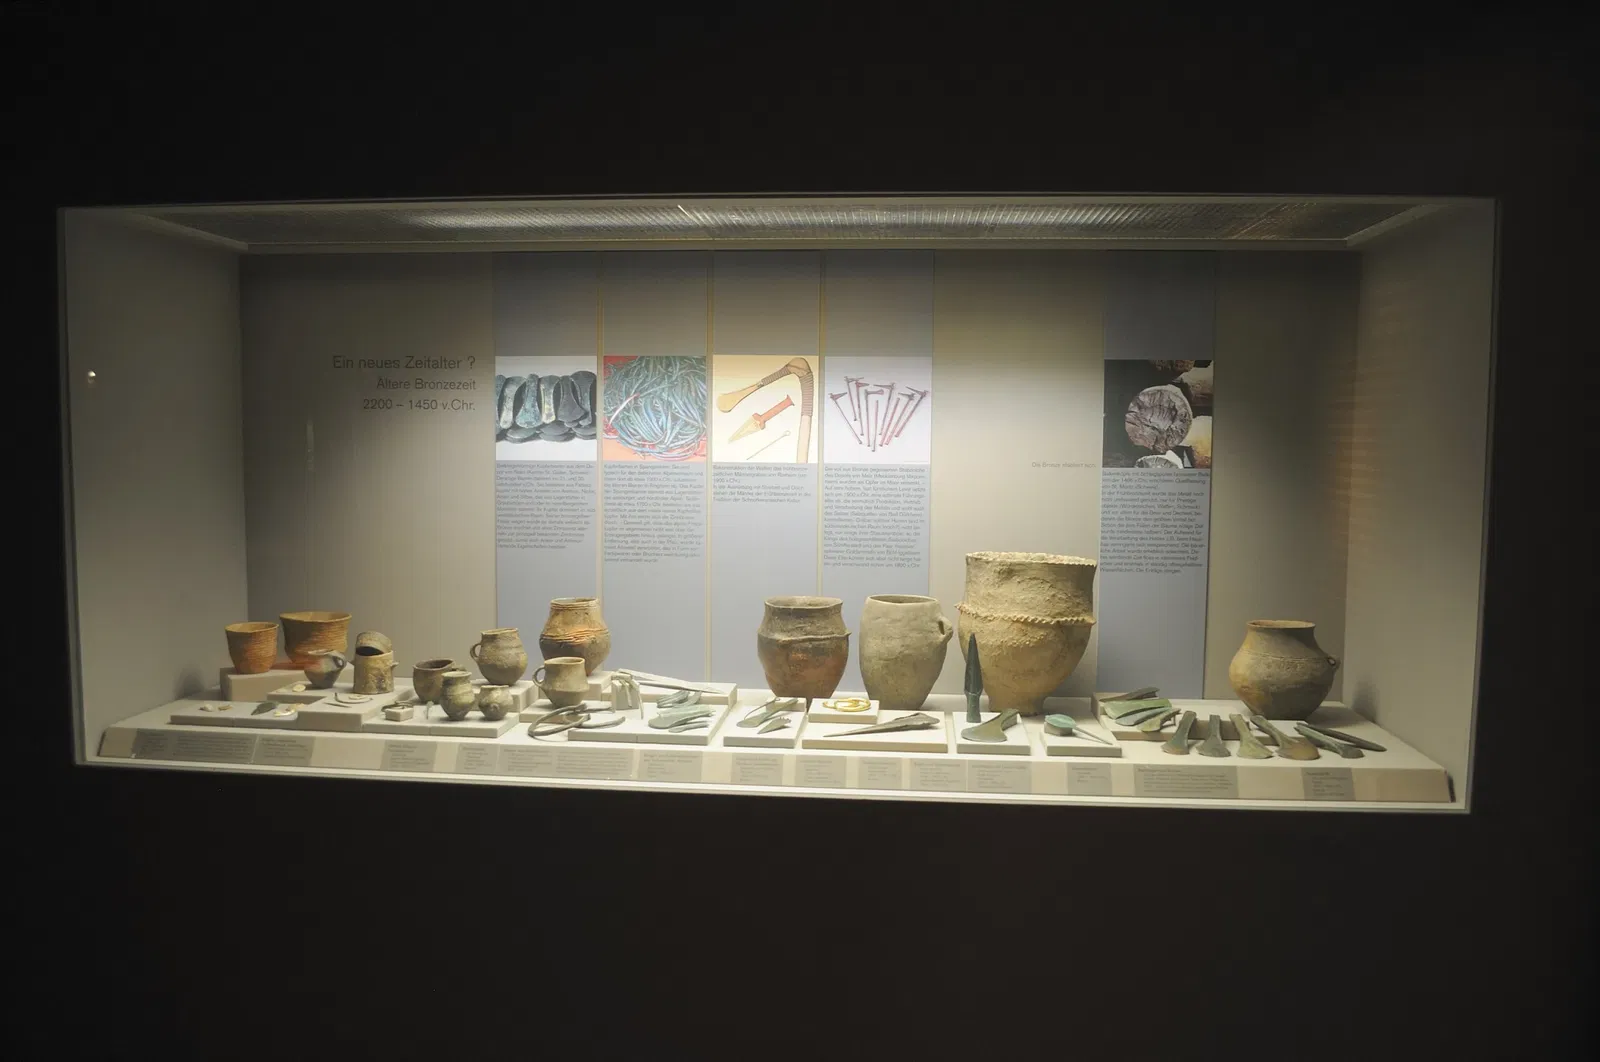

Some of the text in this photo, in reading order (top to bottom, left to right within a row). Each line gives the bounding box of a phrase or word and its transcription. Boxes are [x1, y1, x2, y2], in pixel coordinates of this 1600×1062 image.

[332, 355, 476, 369] Ein neues Zeitalter ?
[414, 378, 477, 391] Bronzezeit
[363, 398, 393, 410] 2200
[408, 398, 438, 410] 1450
